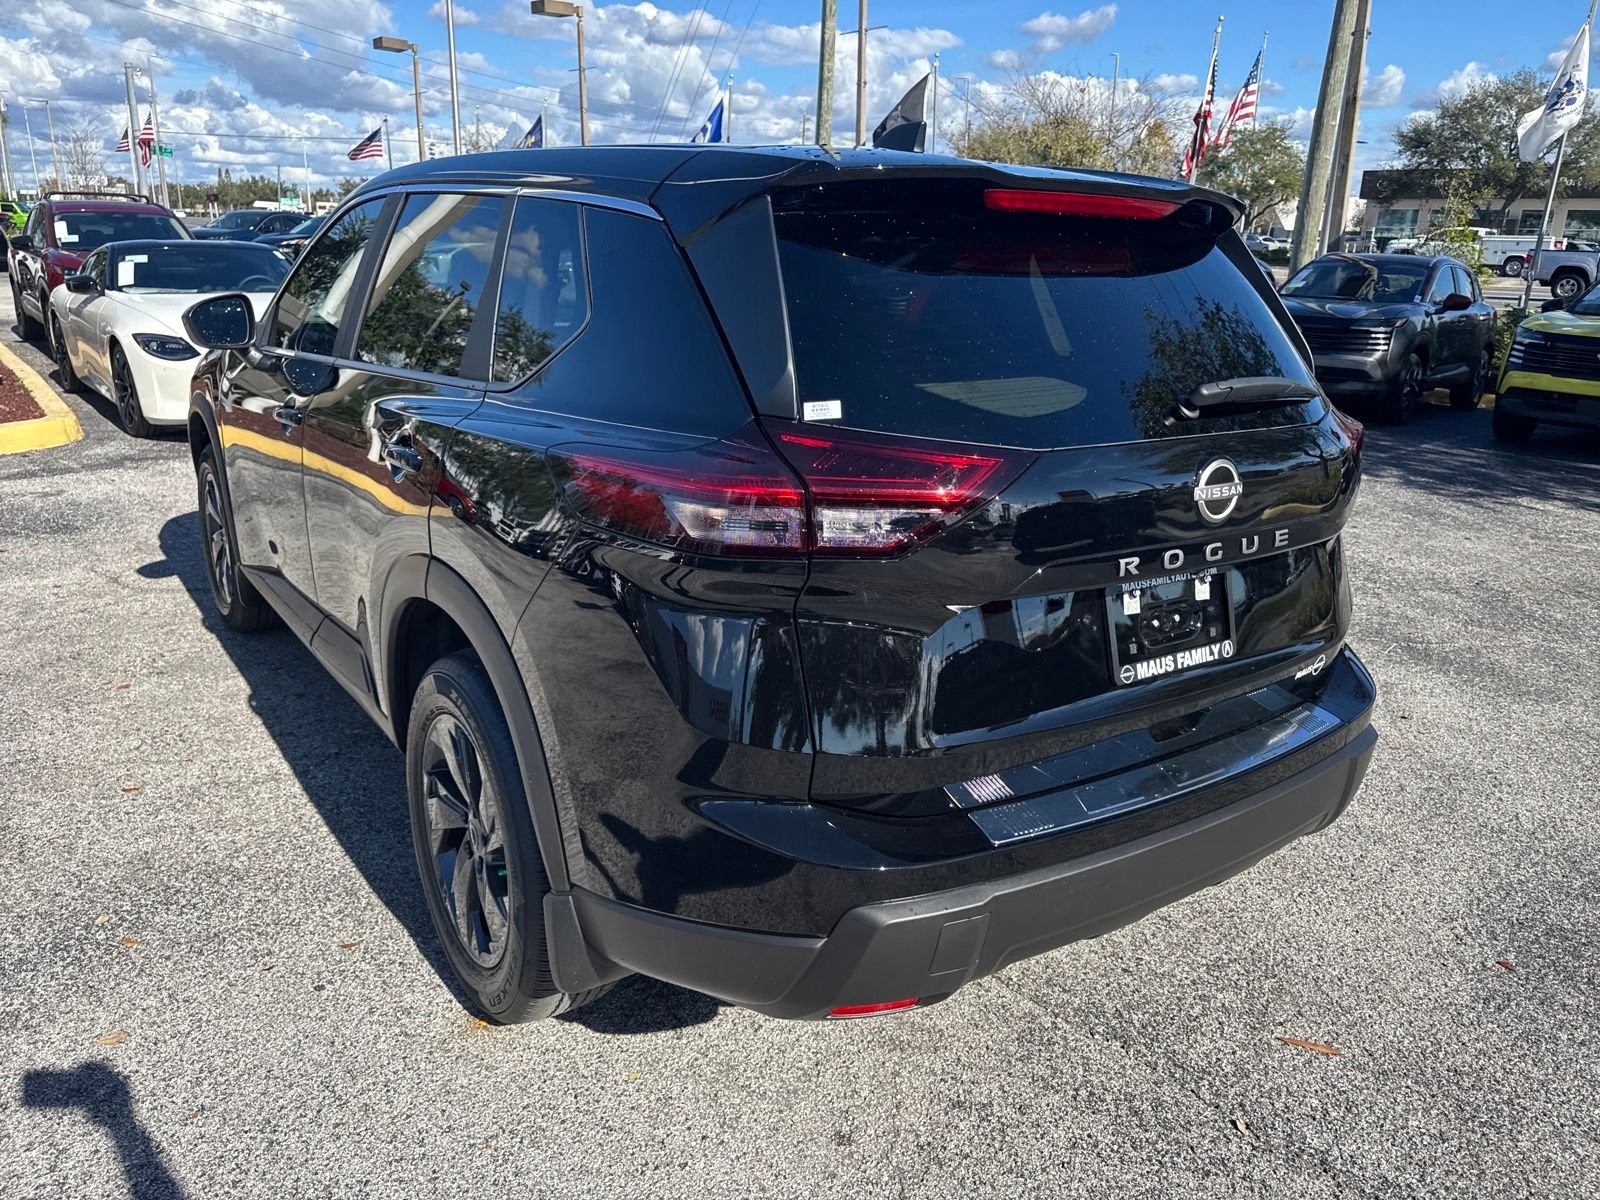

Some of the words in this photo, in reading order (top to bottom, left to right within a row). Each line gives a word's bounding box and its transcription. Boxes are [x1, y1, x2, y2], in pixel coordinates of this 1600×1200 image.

[1195, 483, 1243, 500] NISSAN
[1118, 529, 1289, 577] ROGUE
[1136, 655, 1175, 680] MAUS
[1176, 643, 1221, 669] FAMILY
